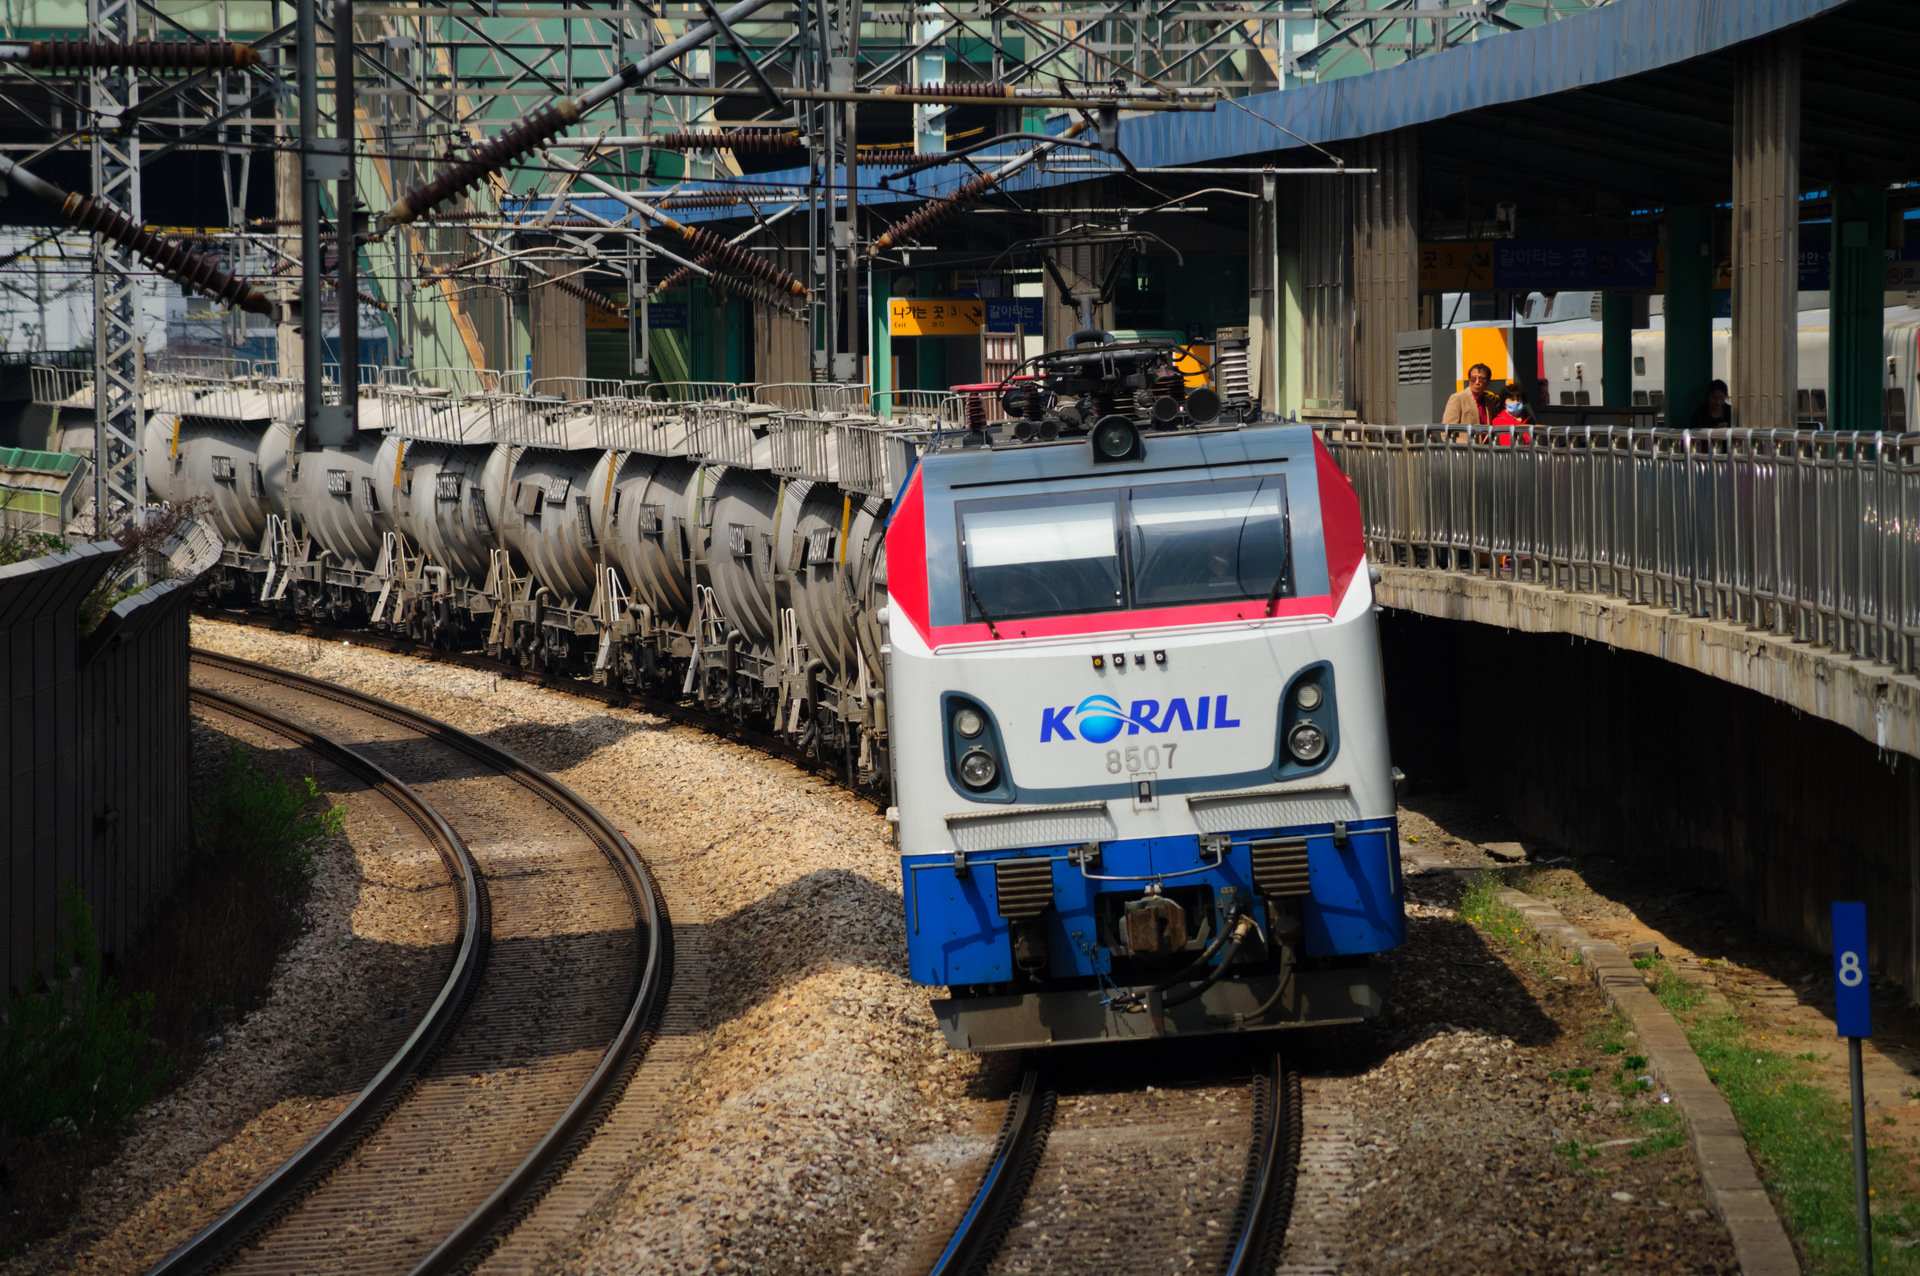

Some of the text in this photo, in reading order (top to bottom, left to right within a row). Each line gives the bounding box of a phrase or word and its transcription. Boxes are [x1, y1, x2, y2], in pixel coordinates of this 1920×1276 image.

[1423, 251, 1453, 269] 곳 3
[1500, 248, 1562, 267] 갈아타는
[1572, 248, 1588, 266] 곳
[894, 306, 927, 319] 나가는
[933, 305, 945, 319] 곳
[990, 305, 1035, 319] 갈아타는
[1040, 694, 1240, 744] KORAIL
[1106, 743, 1178, 774] 8507
[1839, 951, 1863, 987] 8
